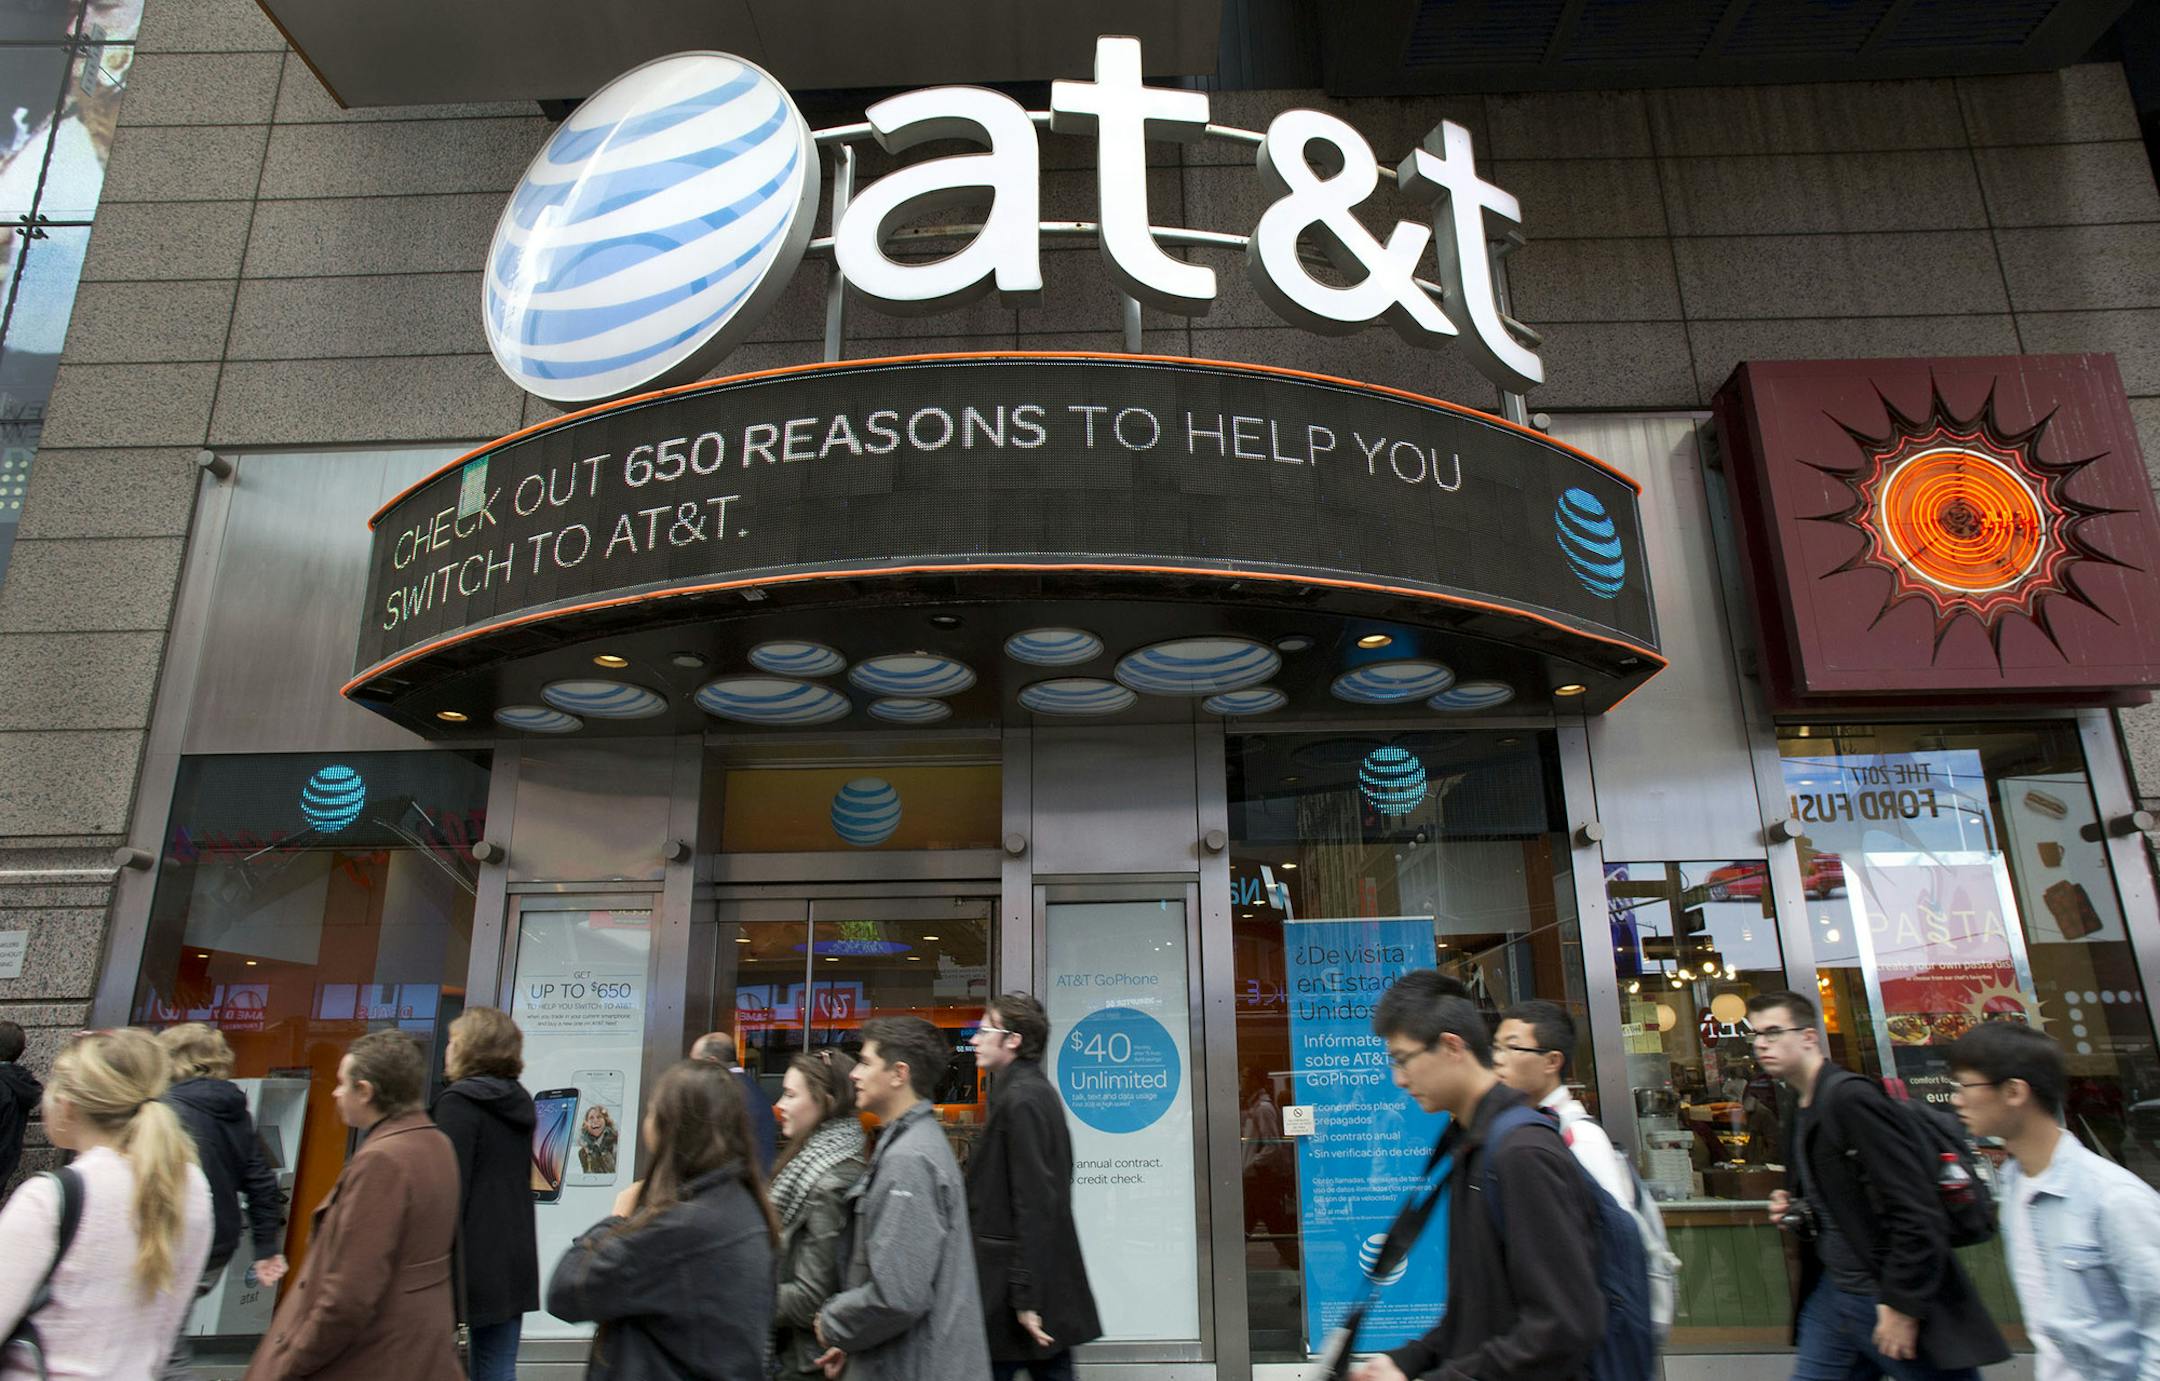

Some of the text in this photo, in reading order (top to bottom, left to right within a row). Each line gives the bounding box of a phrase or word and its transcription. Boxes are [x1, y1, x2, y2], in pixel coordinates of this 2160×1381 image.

[835, 35, 1545, 392] at&t
[393, 404, 1462, 570] CHECK OUT 650 REASONS TO HELP YOU
[382, 494, 750, 632] SWITCH TO AT&T.
[1868, 905, 2006, 951] PASTA
[1295, 943, 1405, 965] ¿De visita
[1939, 960, 1962, 970] own
[1964, 960, 1994, 971] pasta
[573, 970, 592, 980] GET
[1056, 973, 1159, 987] AT&T GoPhone
[1297, 971, 1397, 993] en Estad
[530, 981, 632, 999] UP TO $650
[557, 1002, 573, 1010] YOU
[574, 1002, 602, 1010] SWITCH
[603, 1002, 614, 1010] TO
[1070, 1029, 1132, 1064] $40
[1304, 1033, 1381, 1048] Infórmate
[1305, 1051, 1391, 1067] sobre AT&T
[1071, 1069, 1168, 1090] Unlimited
[1909, 1075, 1940, 1085] comfort
[1373, 1101, 1406, 1113] planes
[1313, 1131, 1401, 1143] Sin contrato anual
[1314, 1148, 1330, 1159] Sin
[1331, 1147, 1389, 1158] verificación
[1389, 1147, 1402, 1157] de
[1076, 1158, 1112, 1169] annual
[1114, 1158, 1163, 1169] contract.
[1076, 1175, 1108, 1185] credit
